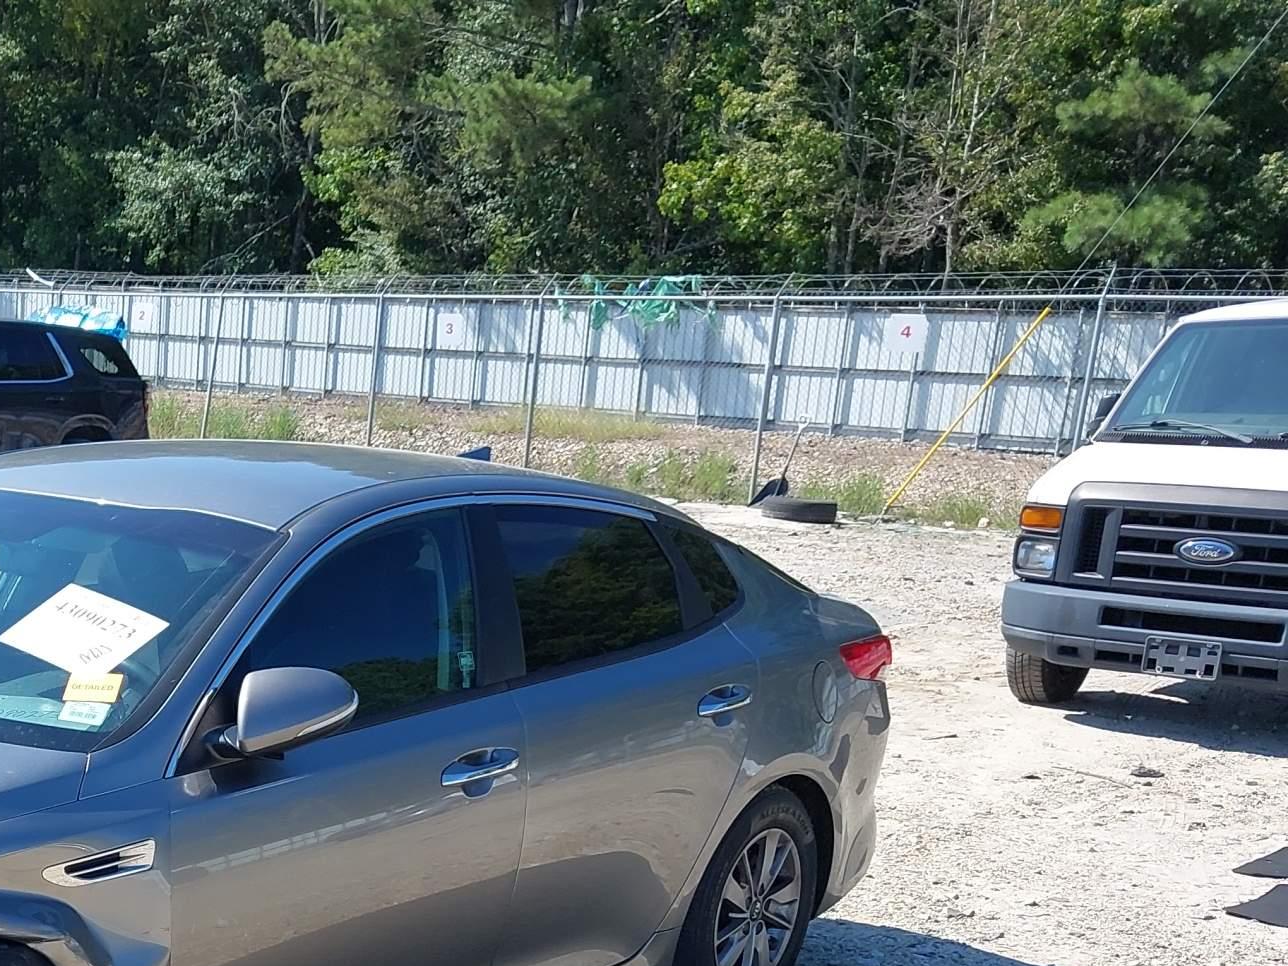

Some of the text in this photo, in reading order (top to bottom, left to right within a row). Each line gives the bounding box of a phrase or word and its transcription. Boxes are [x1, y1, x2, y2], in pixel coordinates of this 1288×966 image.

[138, 310, 146, 321] 2
[445, 323, 454, 335] 3
[900, 325, 912, 339] 4
[1190, 544, 1221, 558] Ford
[56, 601, 137, 639] 43090273
